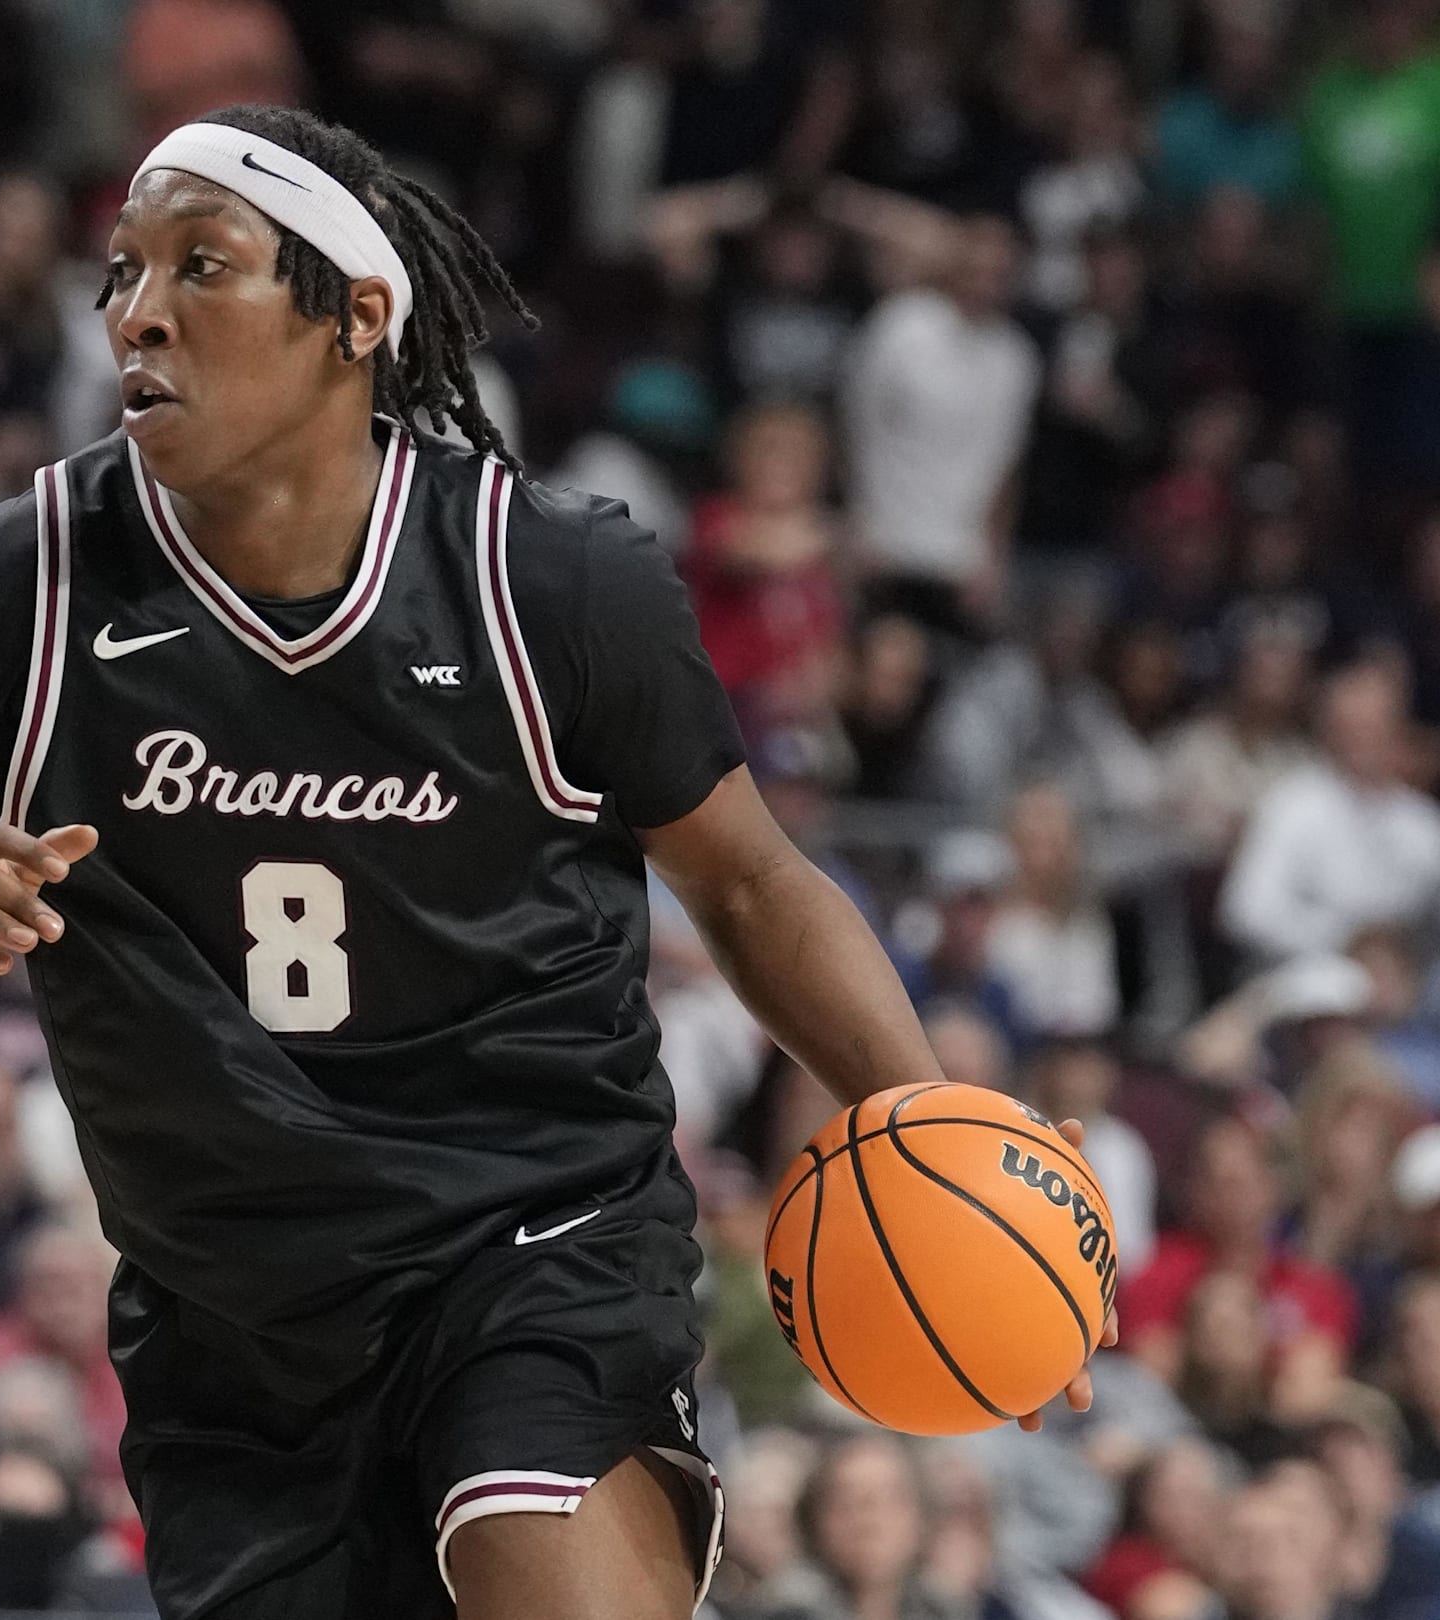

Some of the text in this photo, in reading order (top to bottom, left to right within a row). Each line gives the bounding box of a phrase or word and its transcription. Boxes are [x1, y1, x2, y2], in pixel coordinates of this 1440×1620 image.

[410, 665, 461, 685] WCC
[122, 729, 458, 822] Broncos
[240, 860, 351, 1033] 8
